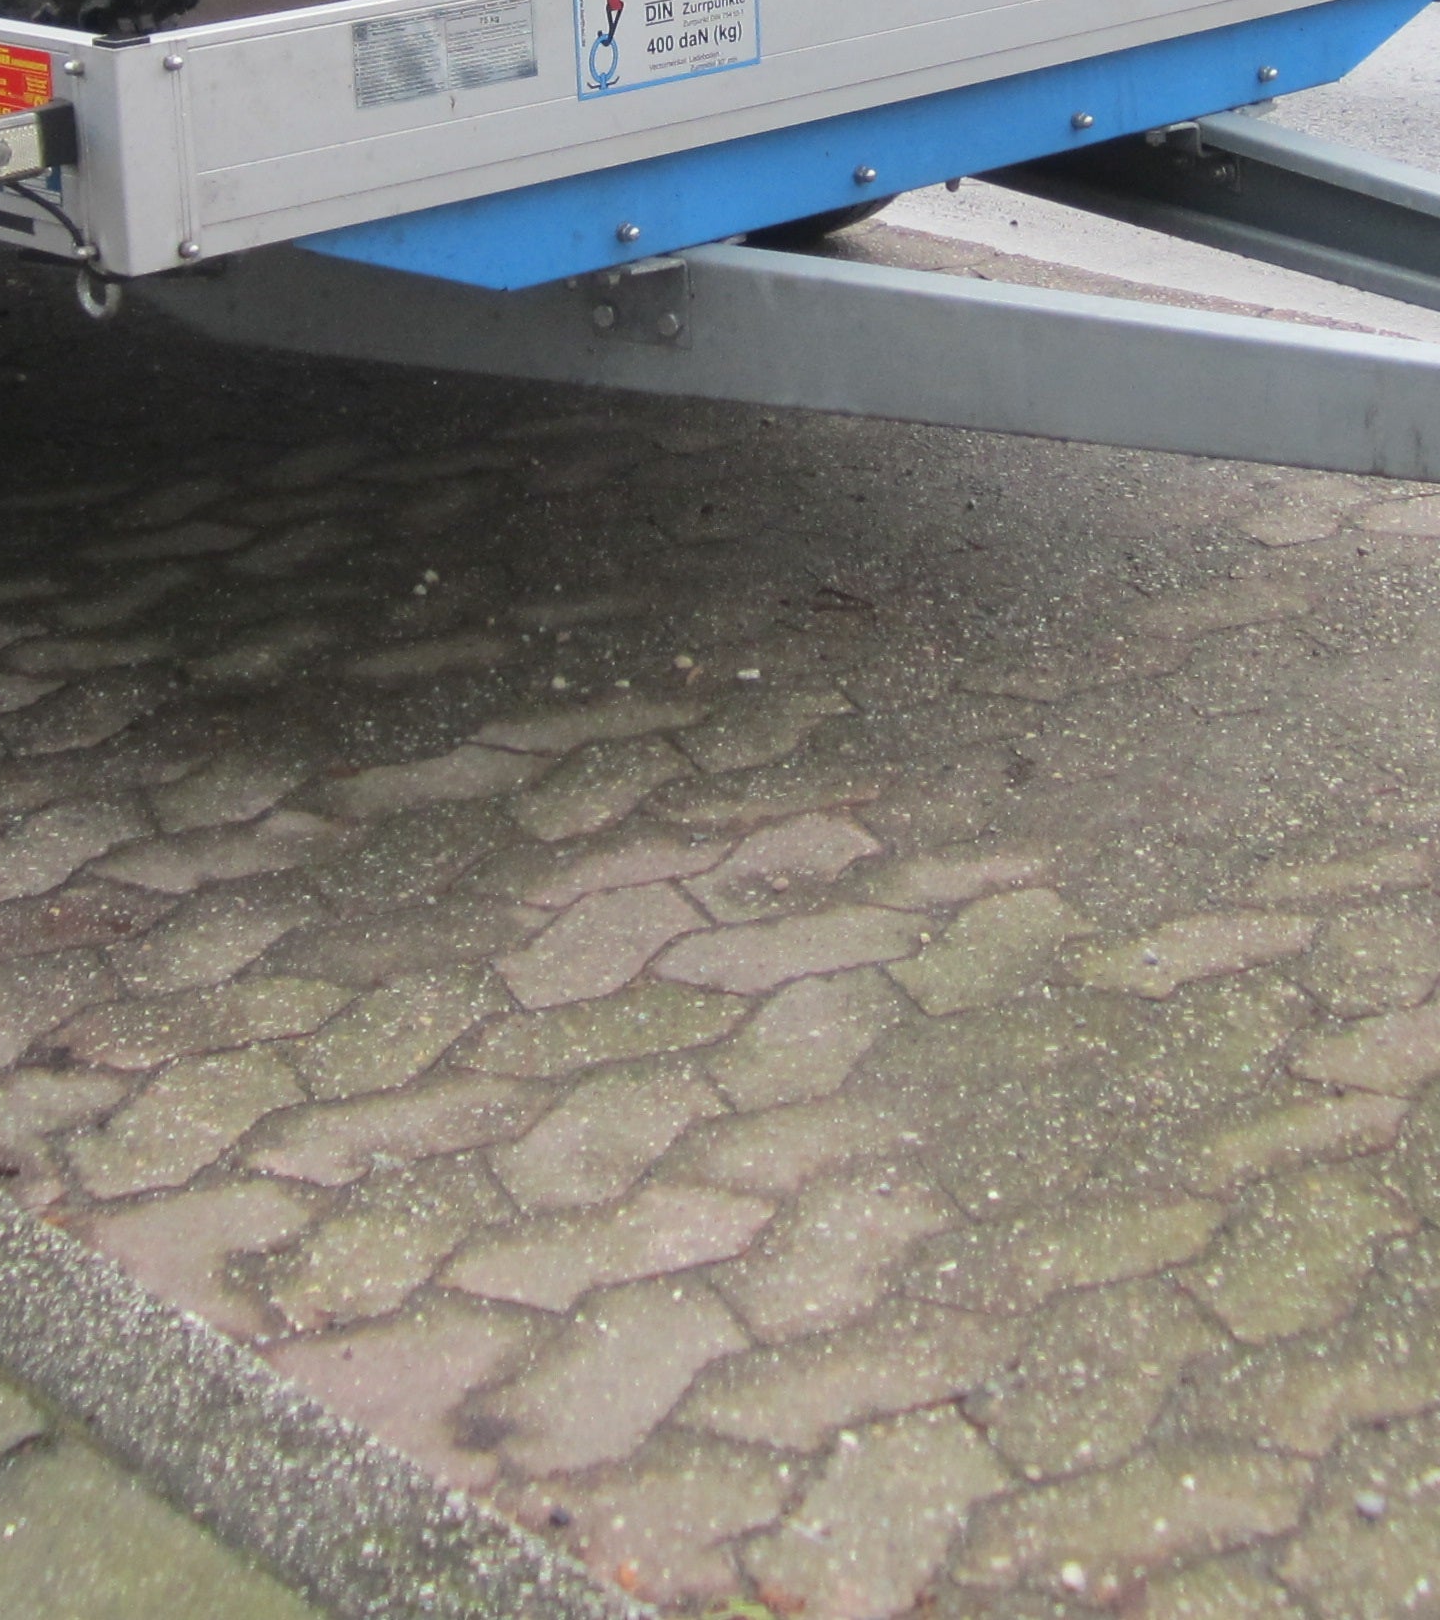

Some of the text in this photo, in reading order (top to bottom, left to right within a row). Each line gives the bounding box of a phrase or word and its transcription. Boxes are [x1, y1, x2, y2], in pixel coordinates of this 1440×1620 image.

[645, 0, 674, 23] DIN
[647, 21, 743, 55] 400 daN (kg)
